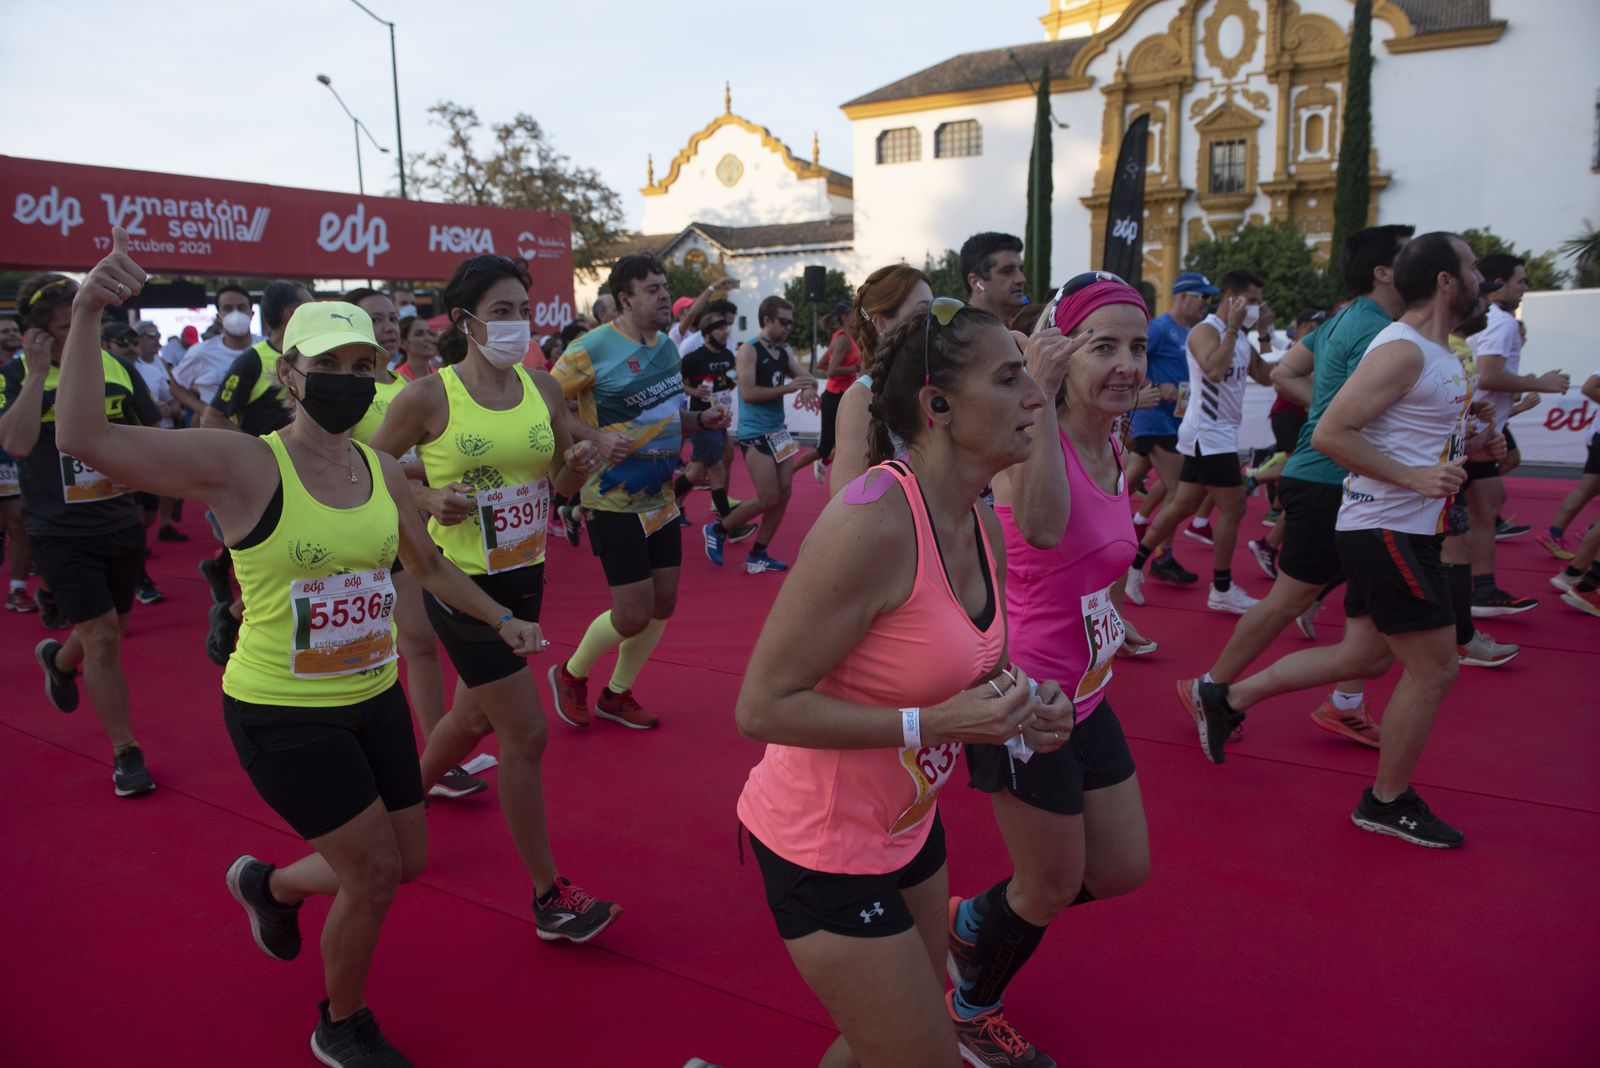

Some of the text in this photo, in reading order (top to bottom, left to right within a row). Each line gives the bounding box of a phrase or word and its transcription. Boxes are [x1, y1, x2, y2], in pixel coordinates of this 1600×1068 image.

[13, 186, 84, 237] edp
[135, 196, 248, 222] maratón
[168, 217, 249, 242] sevilla
[316, 202, 390, 267] edp
[428, 224, 495, 255] HOKA
[94, 237, 212, 254] 17 ctubre 2021
[534, 295, 573, 331] edp
[487, 490, 503, 503] edp
[516, 485, 529, 497] edp
[493, 498, 541, 532] 5391
[303, 579, 325, 594] edp
[344, 574, 362, 589] edp
[309, 592, 382, 630] 5536
[915, 742, 961, 786] 63
